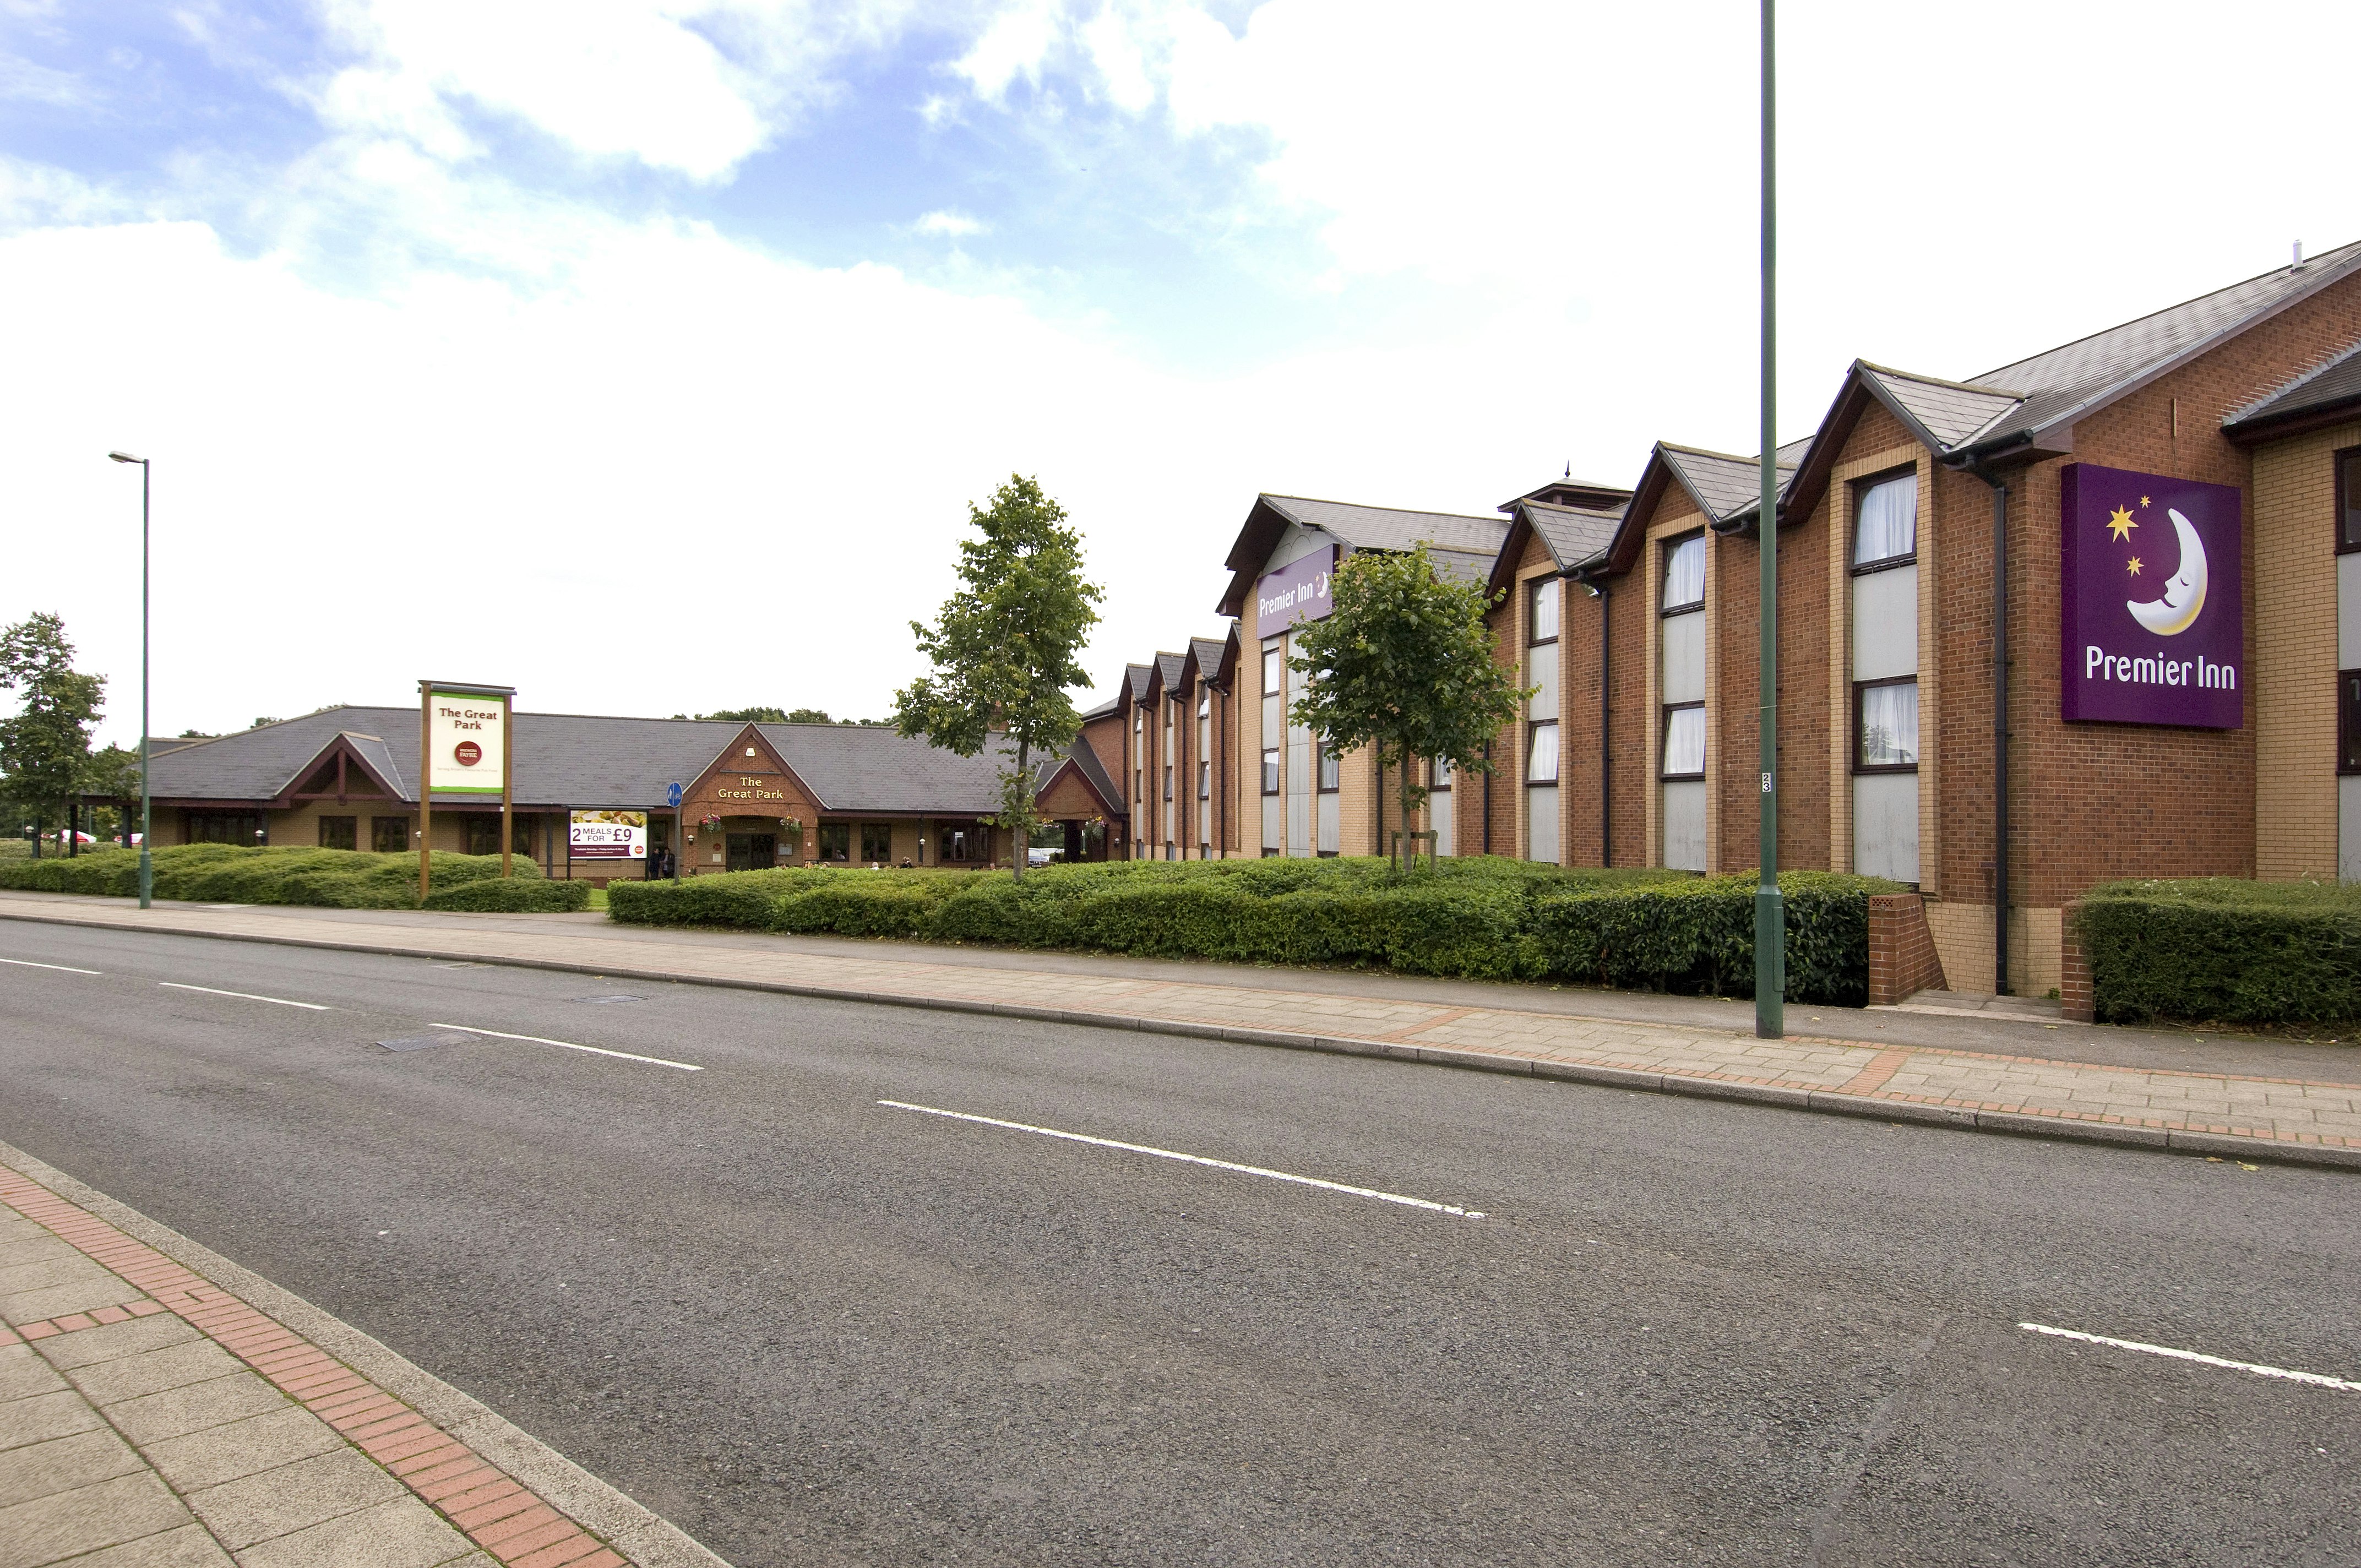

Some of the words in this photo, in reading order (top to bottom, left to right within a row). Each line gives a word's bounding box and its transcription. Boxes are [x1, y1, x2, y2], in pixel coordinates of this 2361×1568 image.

[1260, 589, 1296, 618] Premier
[1298, 582, 1313, 603] Inn
[2086, 645, 2193, 686] Premier
[2197, 655, 2235, 690] Inn
[439, 708, 461, 717] The
[465, 710, 497, 720] Great
[454, 720, 482, 729] Park
[740, 777, 762, 787] The
[718, 789, 752, 799] Great
[756, 790, 784, 799] Park
[572, 828, 581, 842] 2
